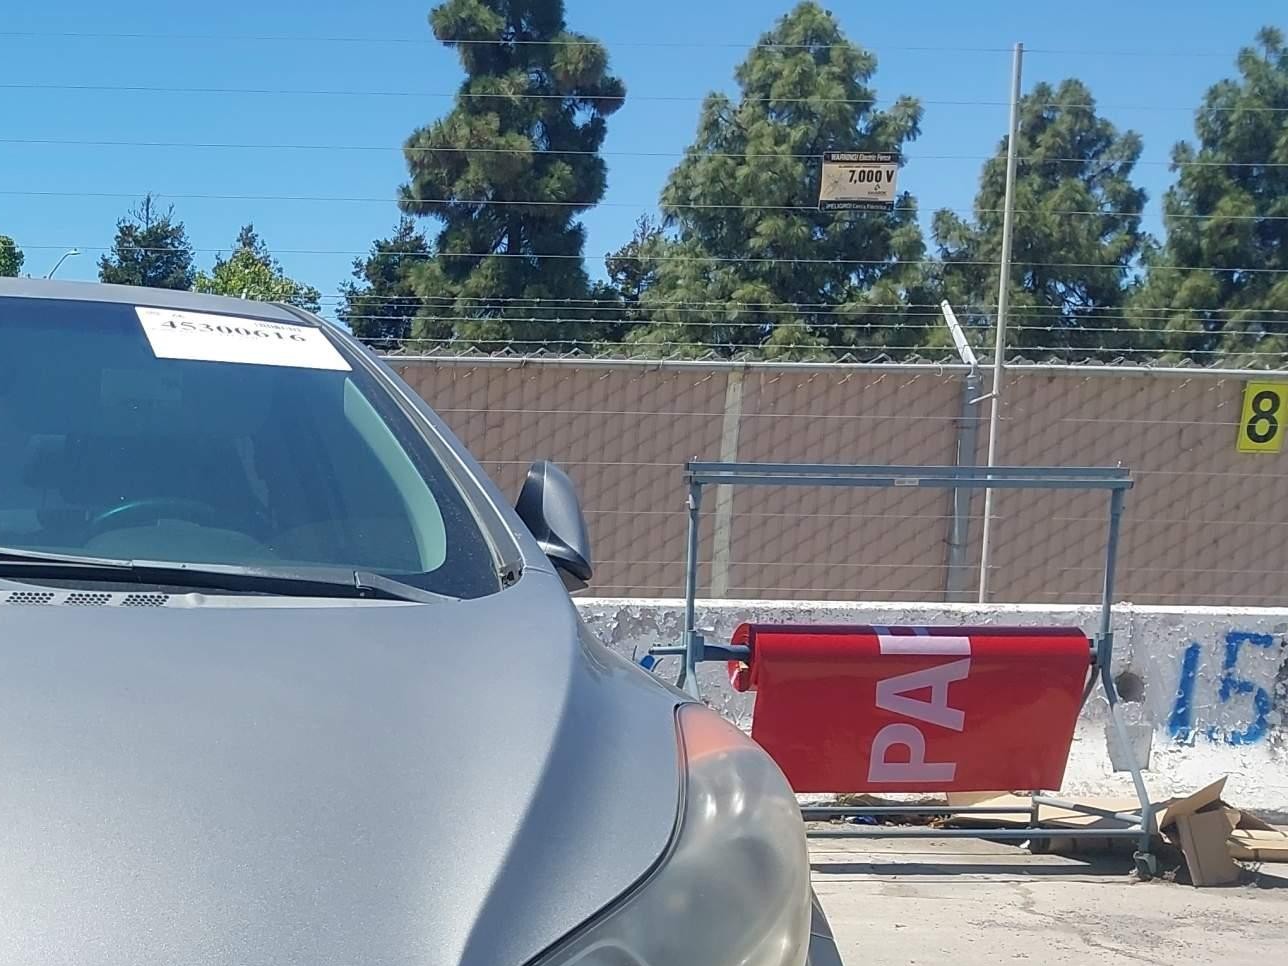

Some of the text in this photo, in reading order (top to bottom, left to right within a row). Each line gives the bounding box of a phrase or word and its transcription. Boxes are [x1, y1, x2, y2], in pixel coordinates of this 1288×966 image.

[848, 169, 895, 184] 7,000 V
[160, 320, 307, 342] 45300616
[1246, 390, 1281, 444] 8
[1167, 630, 1273, 744] 15
